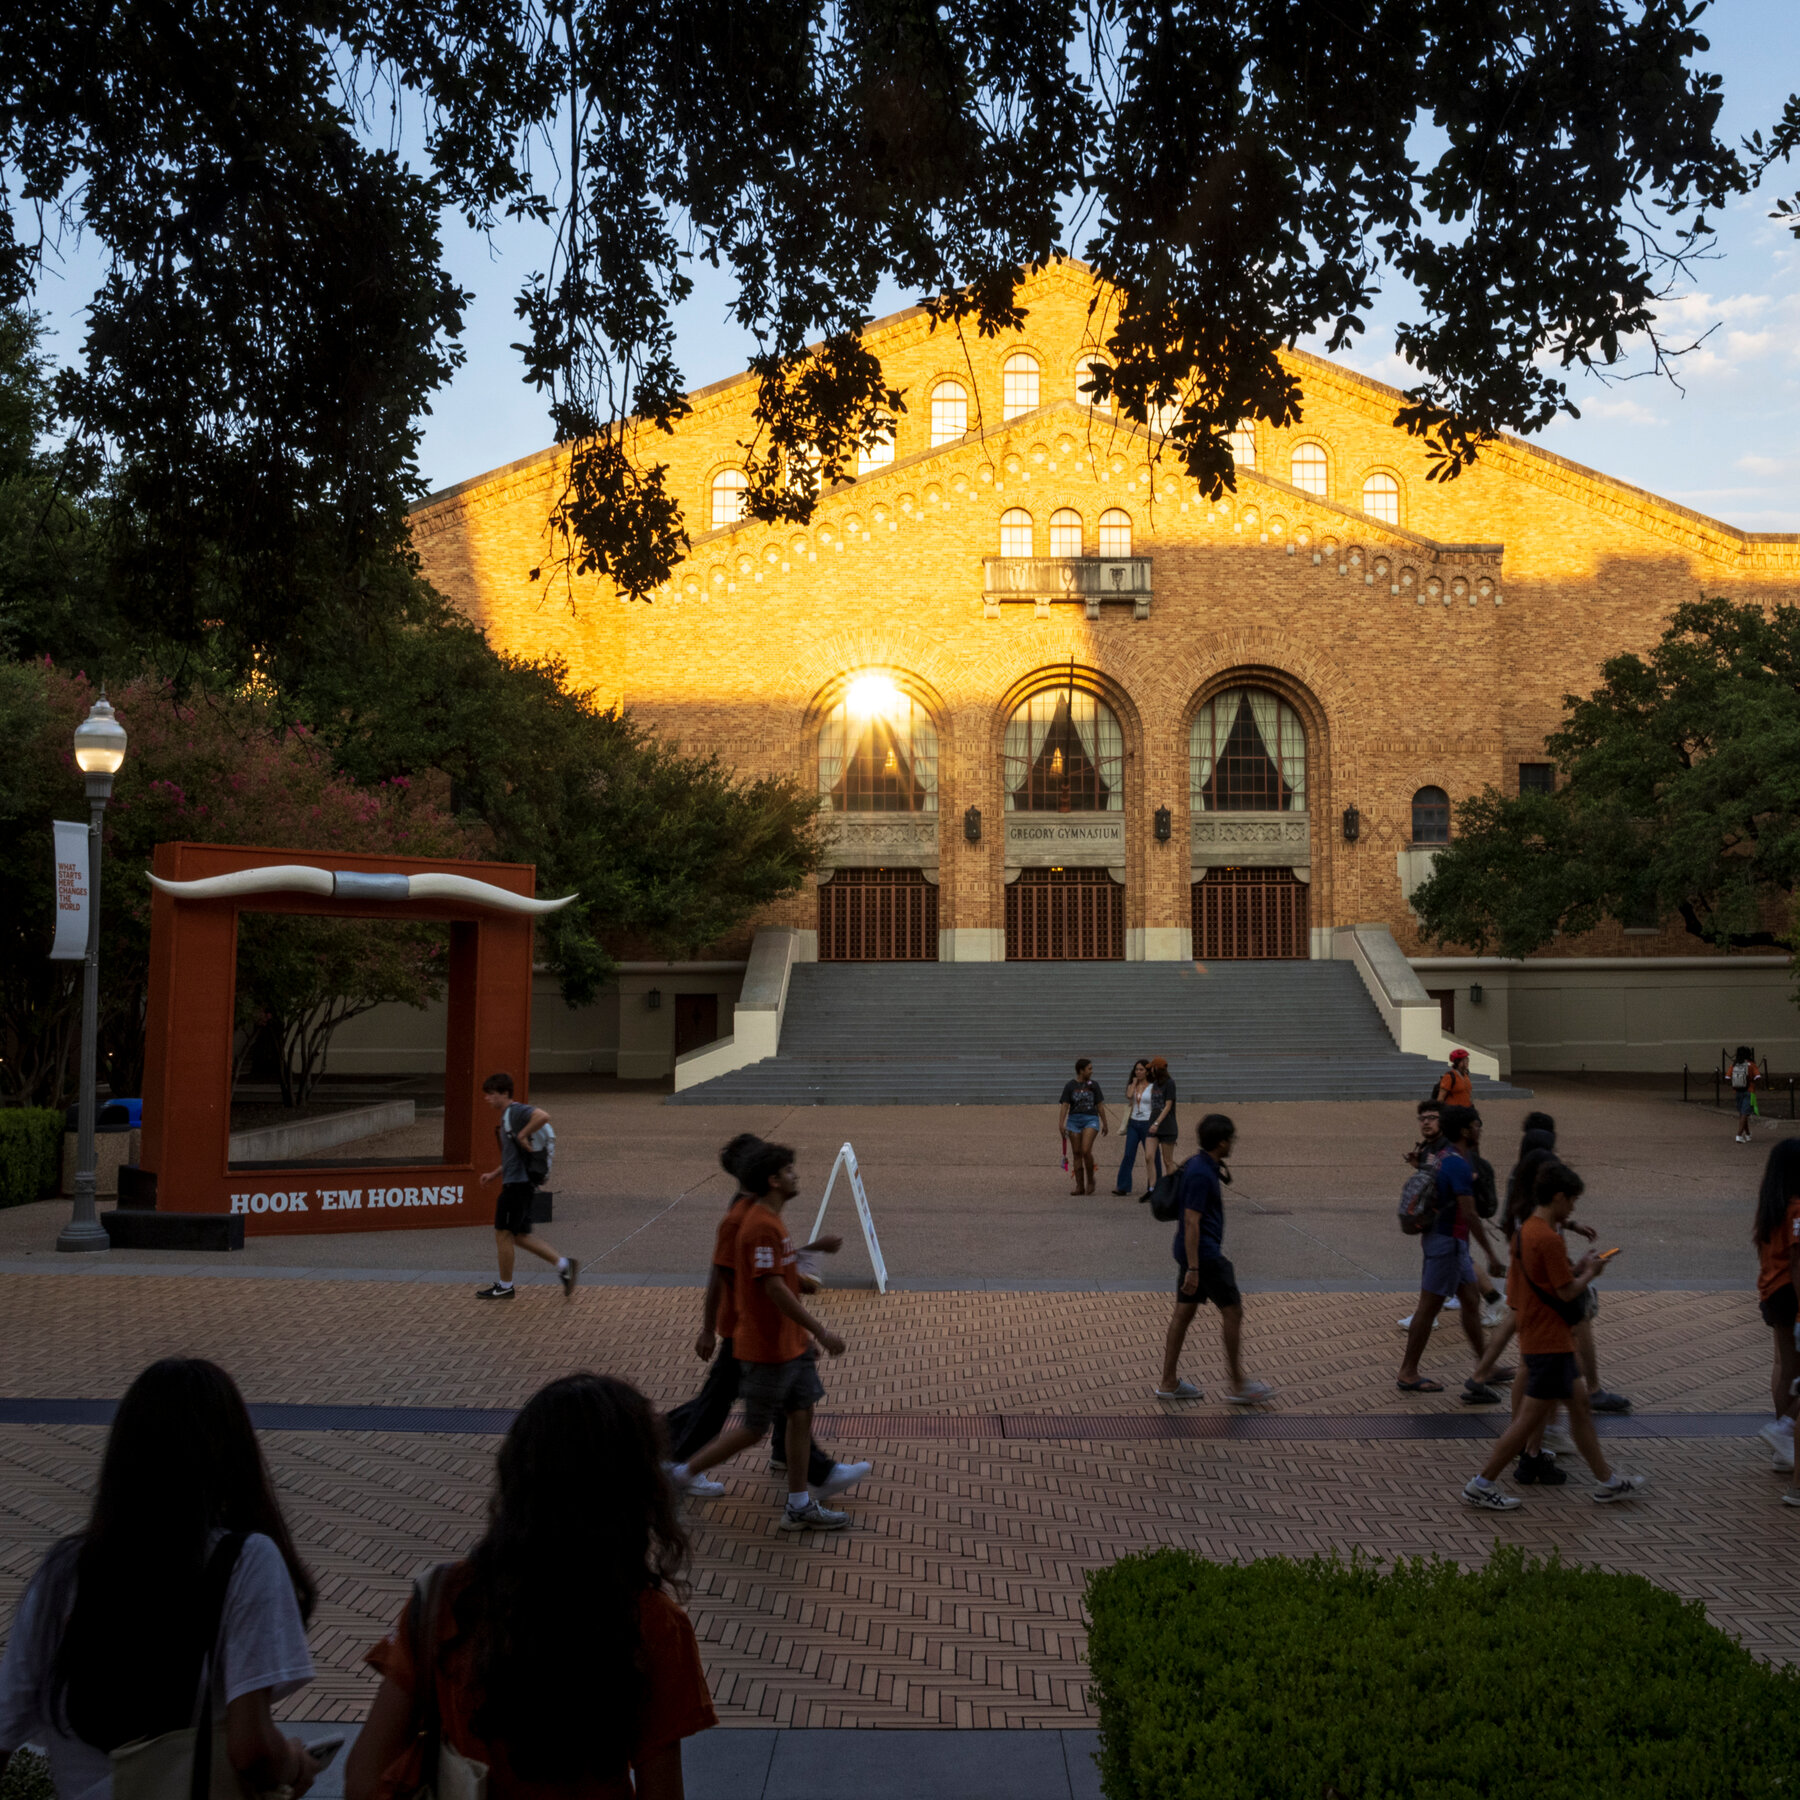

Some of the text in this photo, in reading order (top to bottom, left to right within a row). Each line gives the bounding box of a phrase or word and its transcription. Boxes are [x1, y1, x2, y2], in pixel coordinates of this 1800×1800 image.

[1010, 828, 1119, 839] GREGORY GYMNASIUM
[58, 863, 76, 871] WHAT
[58, 871, 82, 879] STARTS
[58, 879, 74, 887] HERE
[58, 887, 87, 896] CHANGES
[59, 895, 71, 903] THE
[59, 903, 80, 911] WORLD
[230, 1192, 309, 1214] HOOK
[367, 1186, 464, 1208] HORNS!
